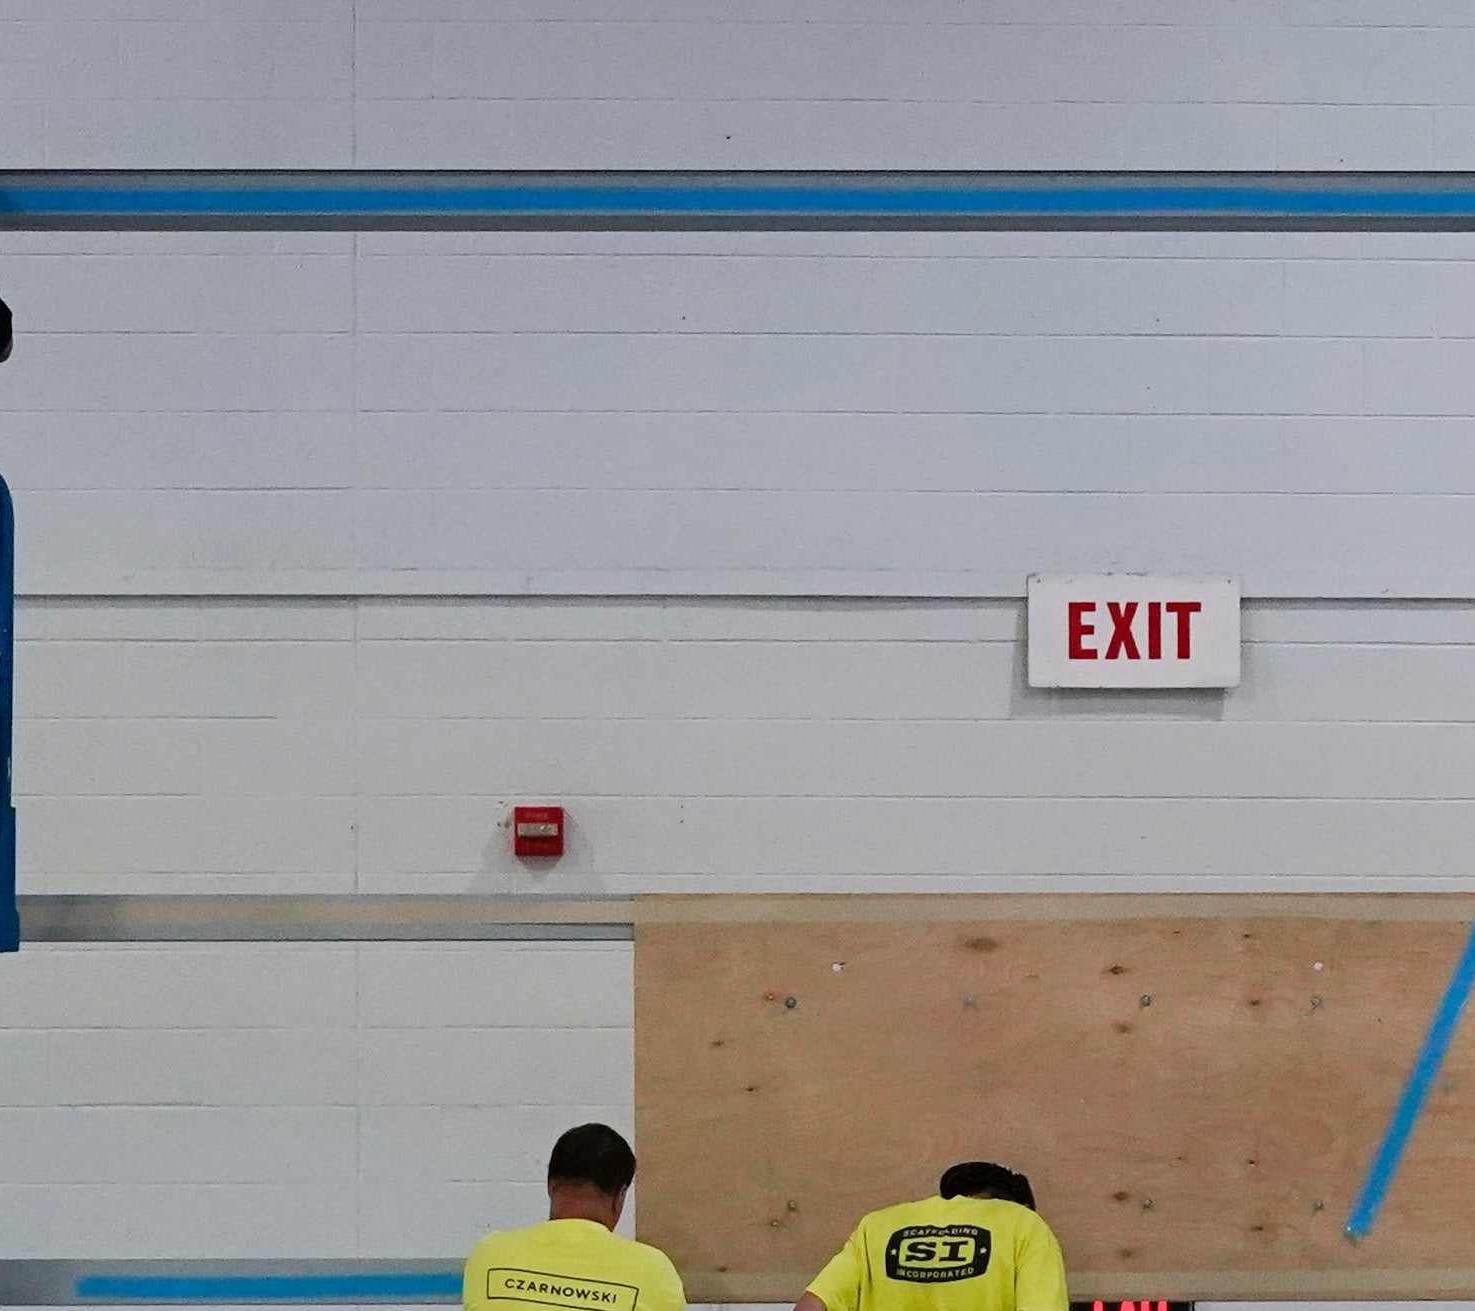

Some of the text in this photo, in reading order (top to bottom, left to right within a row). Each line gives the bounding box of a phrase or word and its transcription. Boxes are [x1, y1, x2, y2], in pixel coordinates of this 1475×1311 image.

[1068, 601, 1202, 660] EXIT
[905, 1241, 968, 1262] SI
[896, 1267, 974, 1279] INCORPORATED
[505, 1278, 617, 1304] CZARNOWSKI
